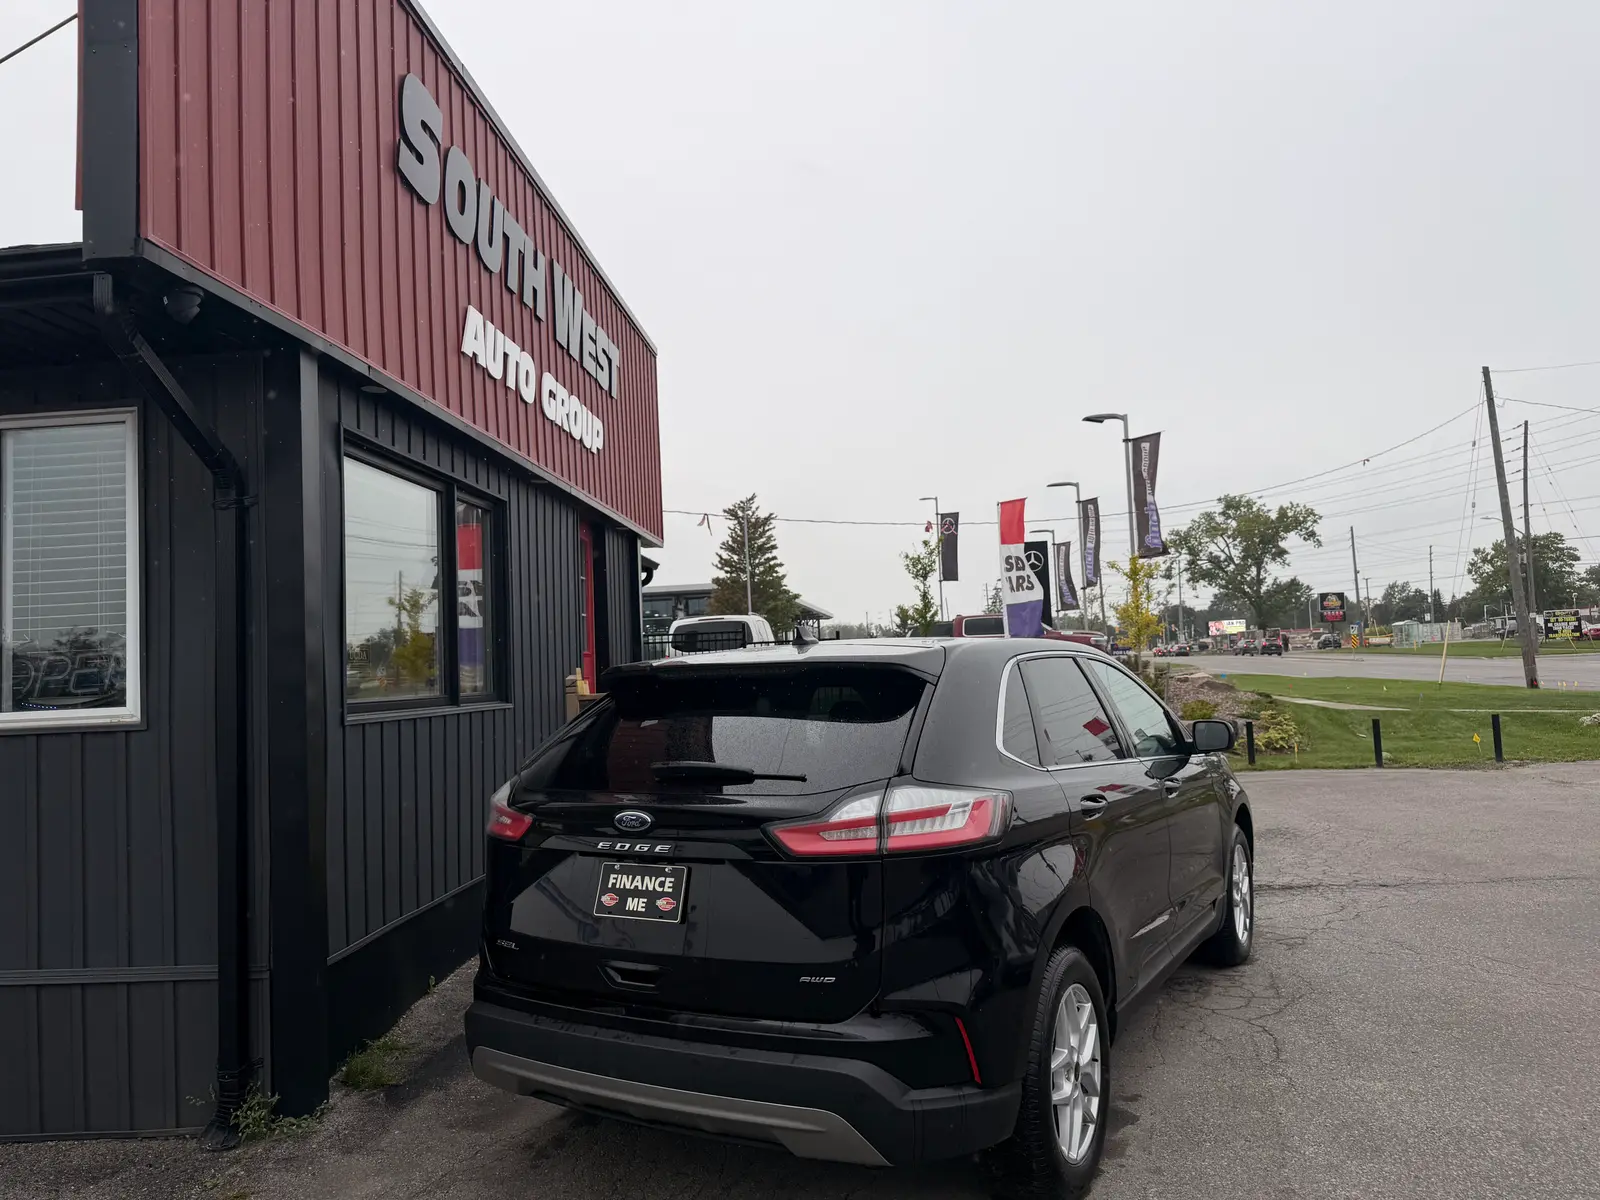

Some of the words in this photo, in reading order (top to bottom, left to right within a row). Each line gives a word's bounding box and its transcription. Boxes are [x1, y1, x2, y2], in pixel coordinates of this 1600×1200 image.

[397, 72, 546, 321] SOUTH
[552, 257, 620, 399] WEST
[460, 304, 536, 404] AUTO
[541, 371, 604, 453] GROUP
[621, 815, 642, 827] Ford
[596, 841, 672, 853] EDGE
[608, 873, 675, 893] FINANCE
[625, 896, 648, 912] ME
